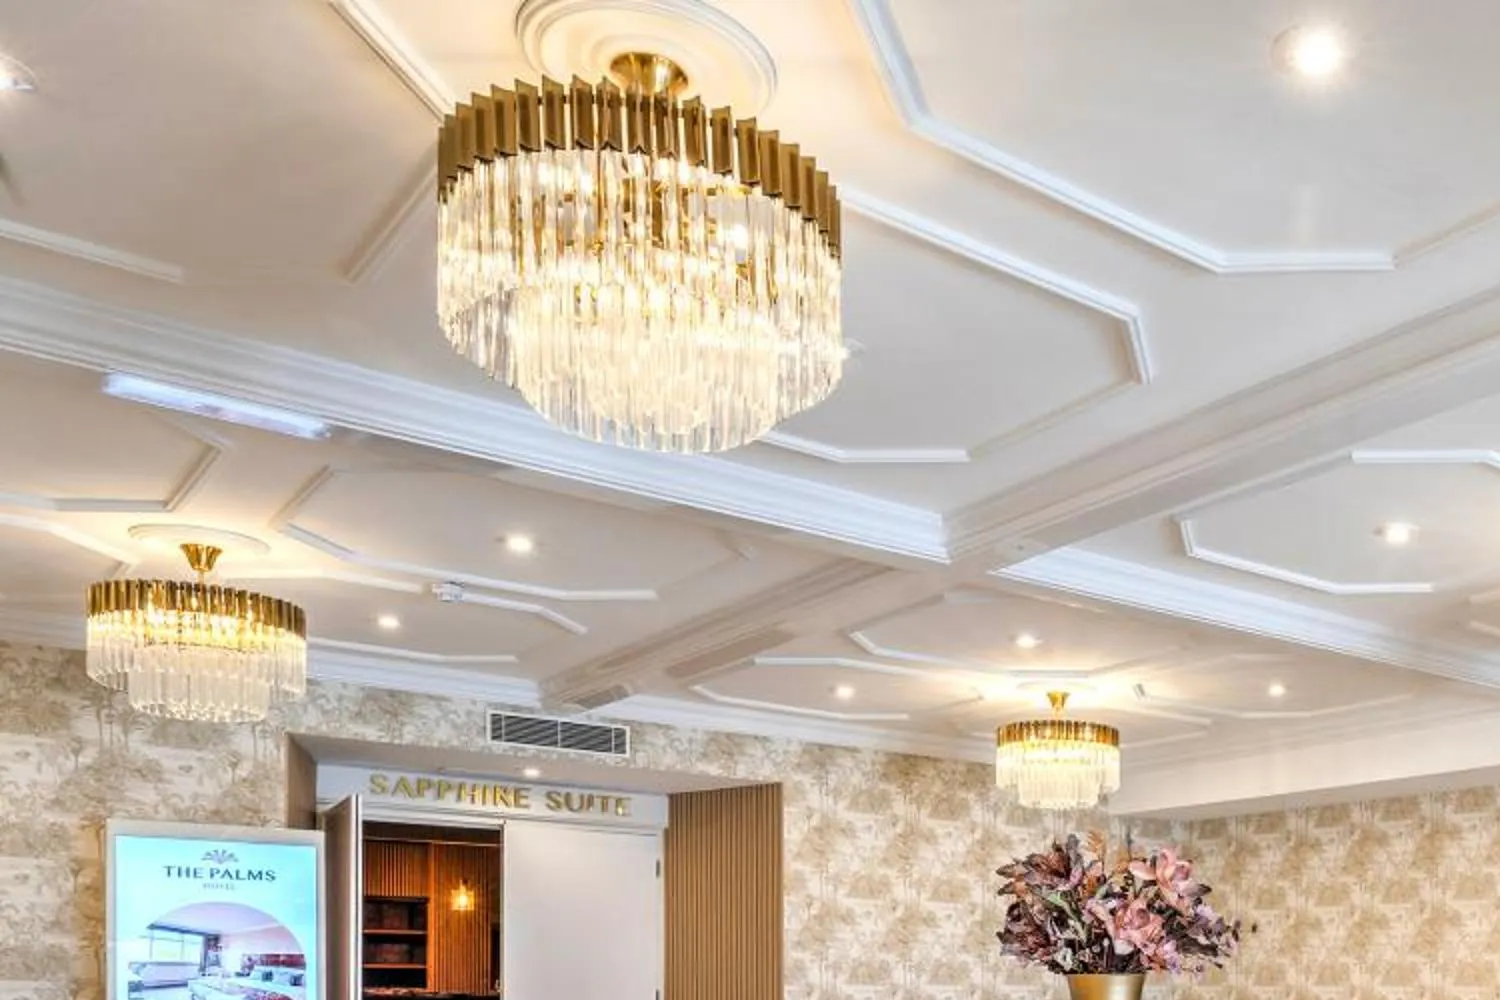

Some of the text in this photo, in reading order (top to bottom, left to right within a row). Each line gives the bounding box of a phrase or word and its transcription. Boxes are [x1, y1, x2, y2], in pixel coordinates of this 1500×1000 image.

[369, 773, 632, 816] SAPPHIRE SUITE
[163, 865, 277, 882] THE PALMS
